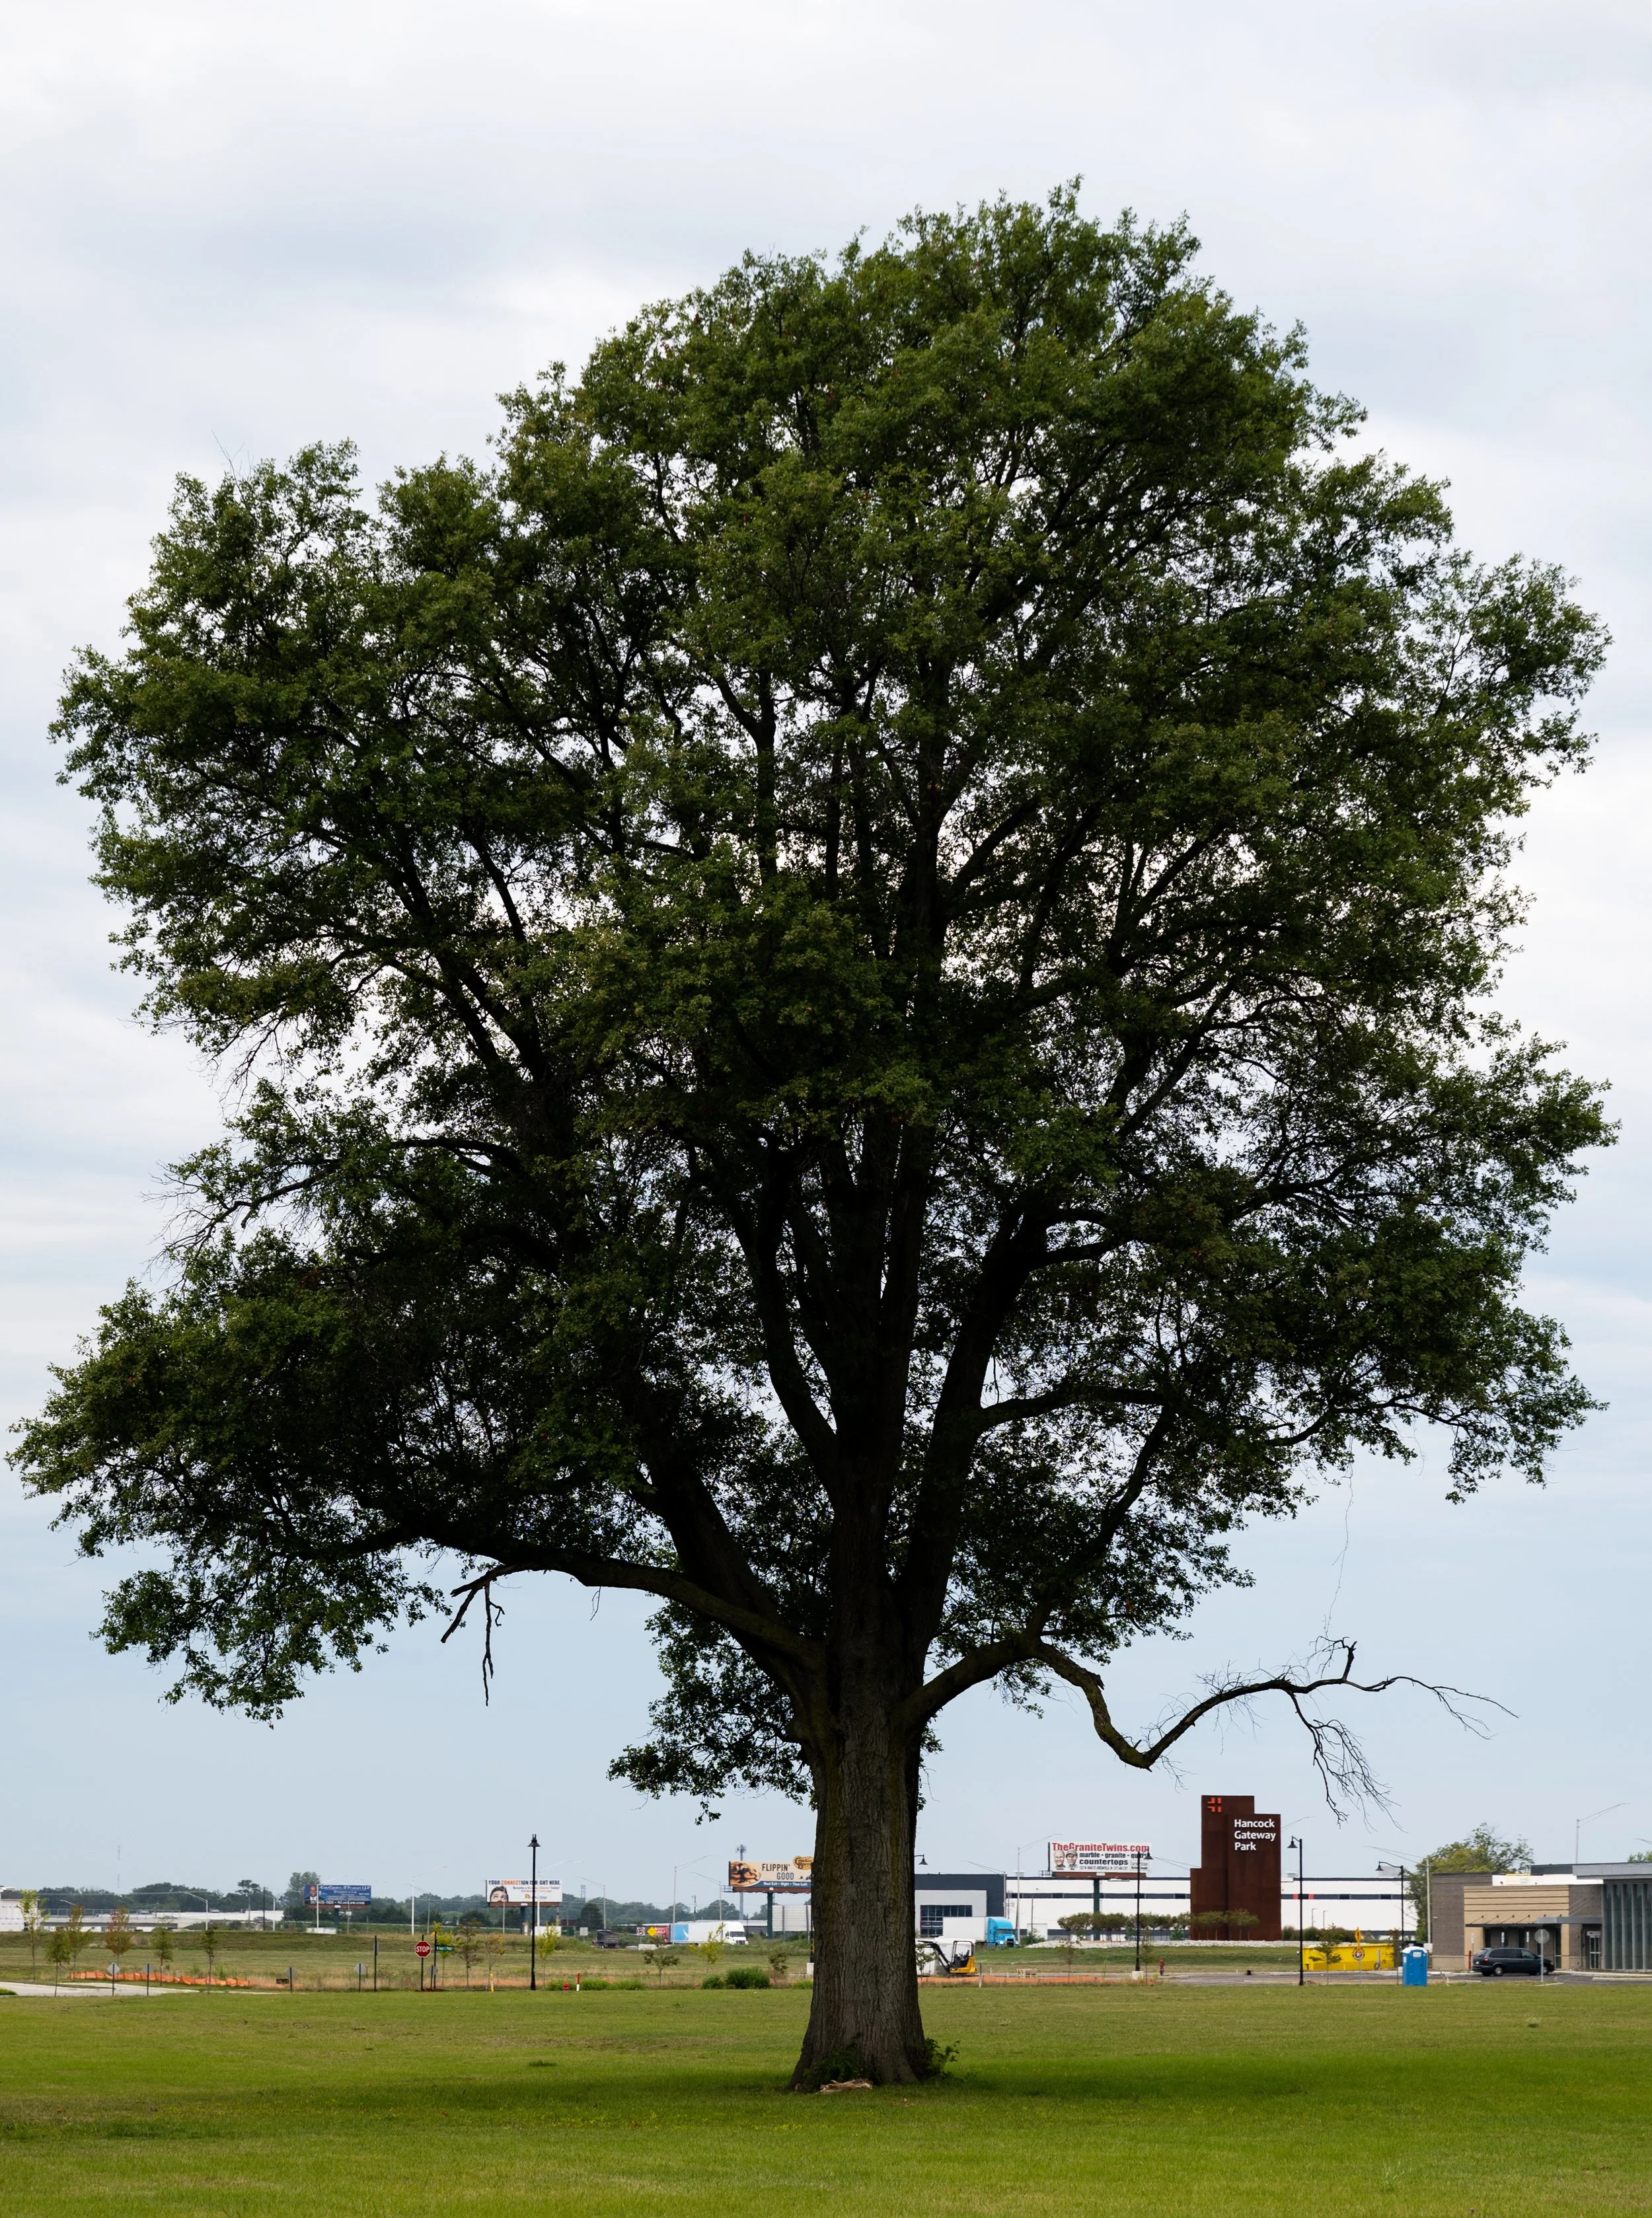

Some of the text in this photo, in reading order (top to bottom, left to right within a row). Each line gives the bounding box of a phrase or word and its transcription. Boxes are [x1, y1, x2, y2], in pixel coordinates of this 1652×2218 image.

[1234, 1819, 1275, 1828] Hancock
[1234, 1831, 1276, 1841] Gateway
[1052, 1842, 1150, 1852] TheGraniteTwins.com
[1234, 1842, 1257, 1851] Park
[762, 1863, 790, 1872] FLIPPIN'
